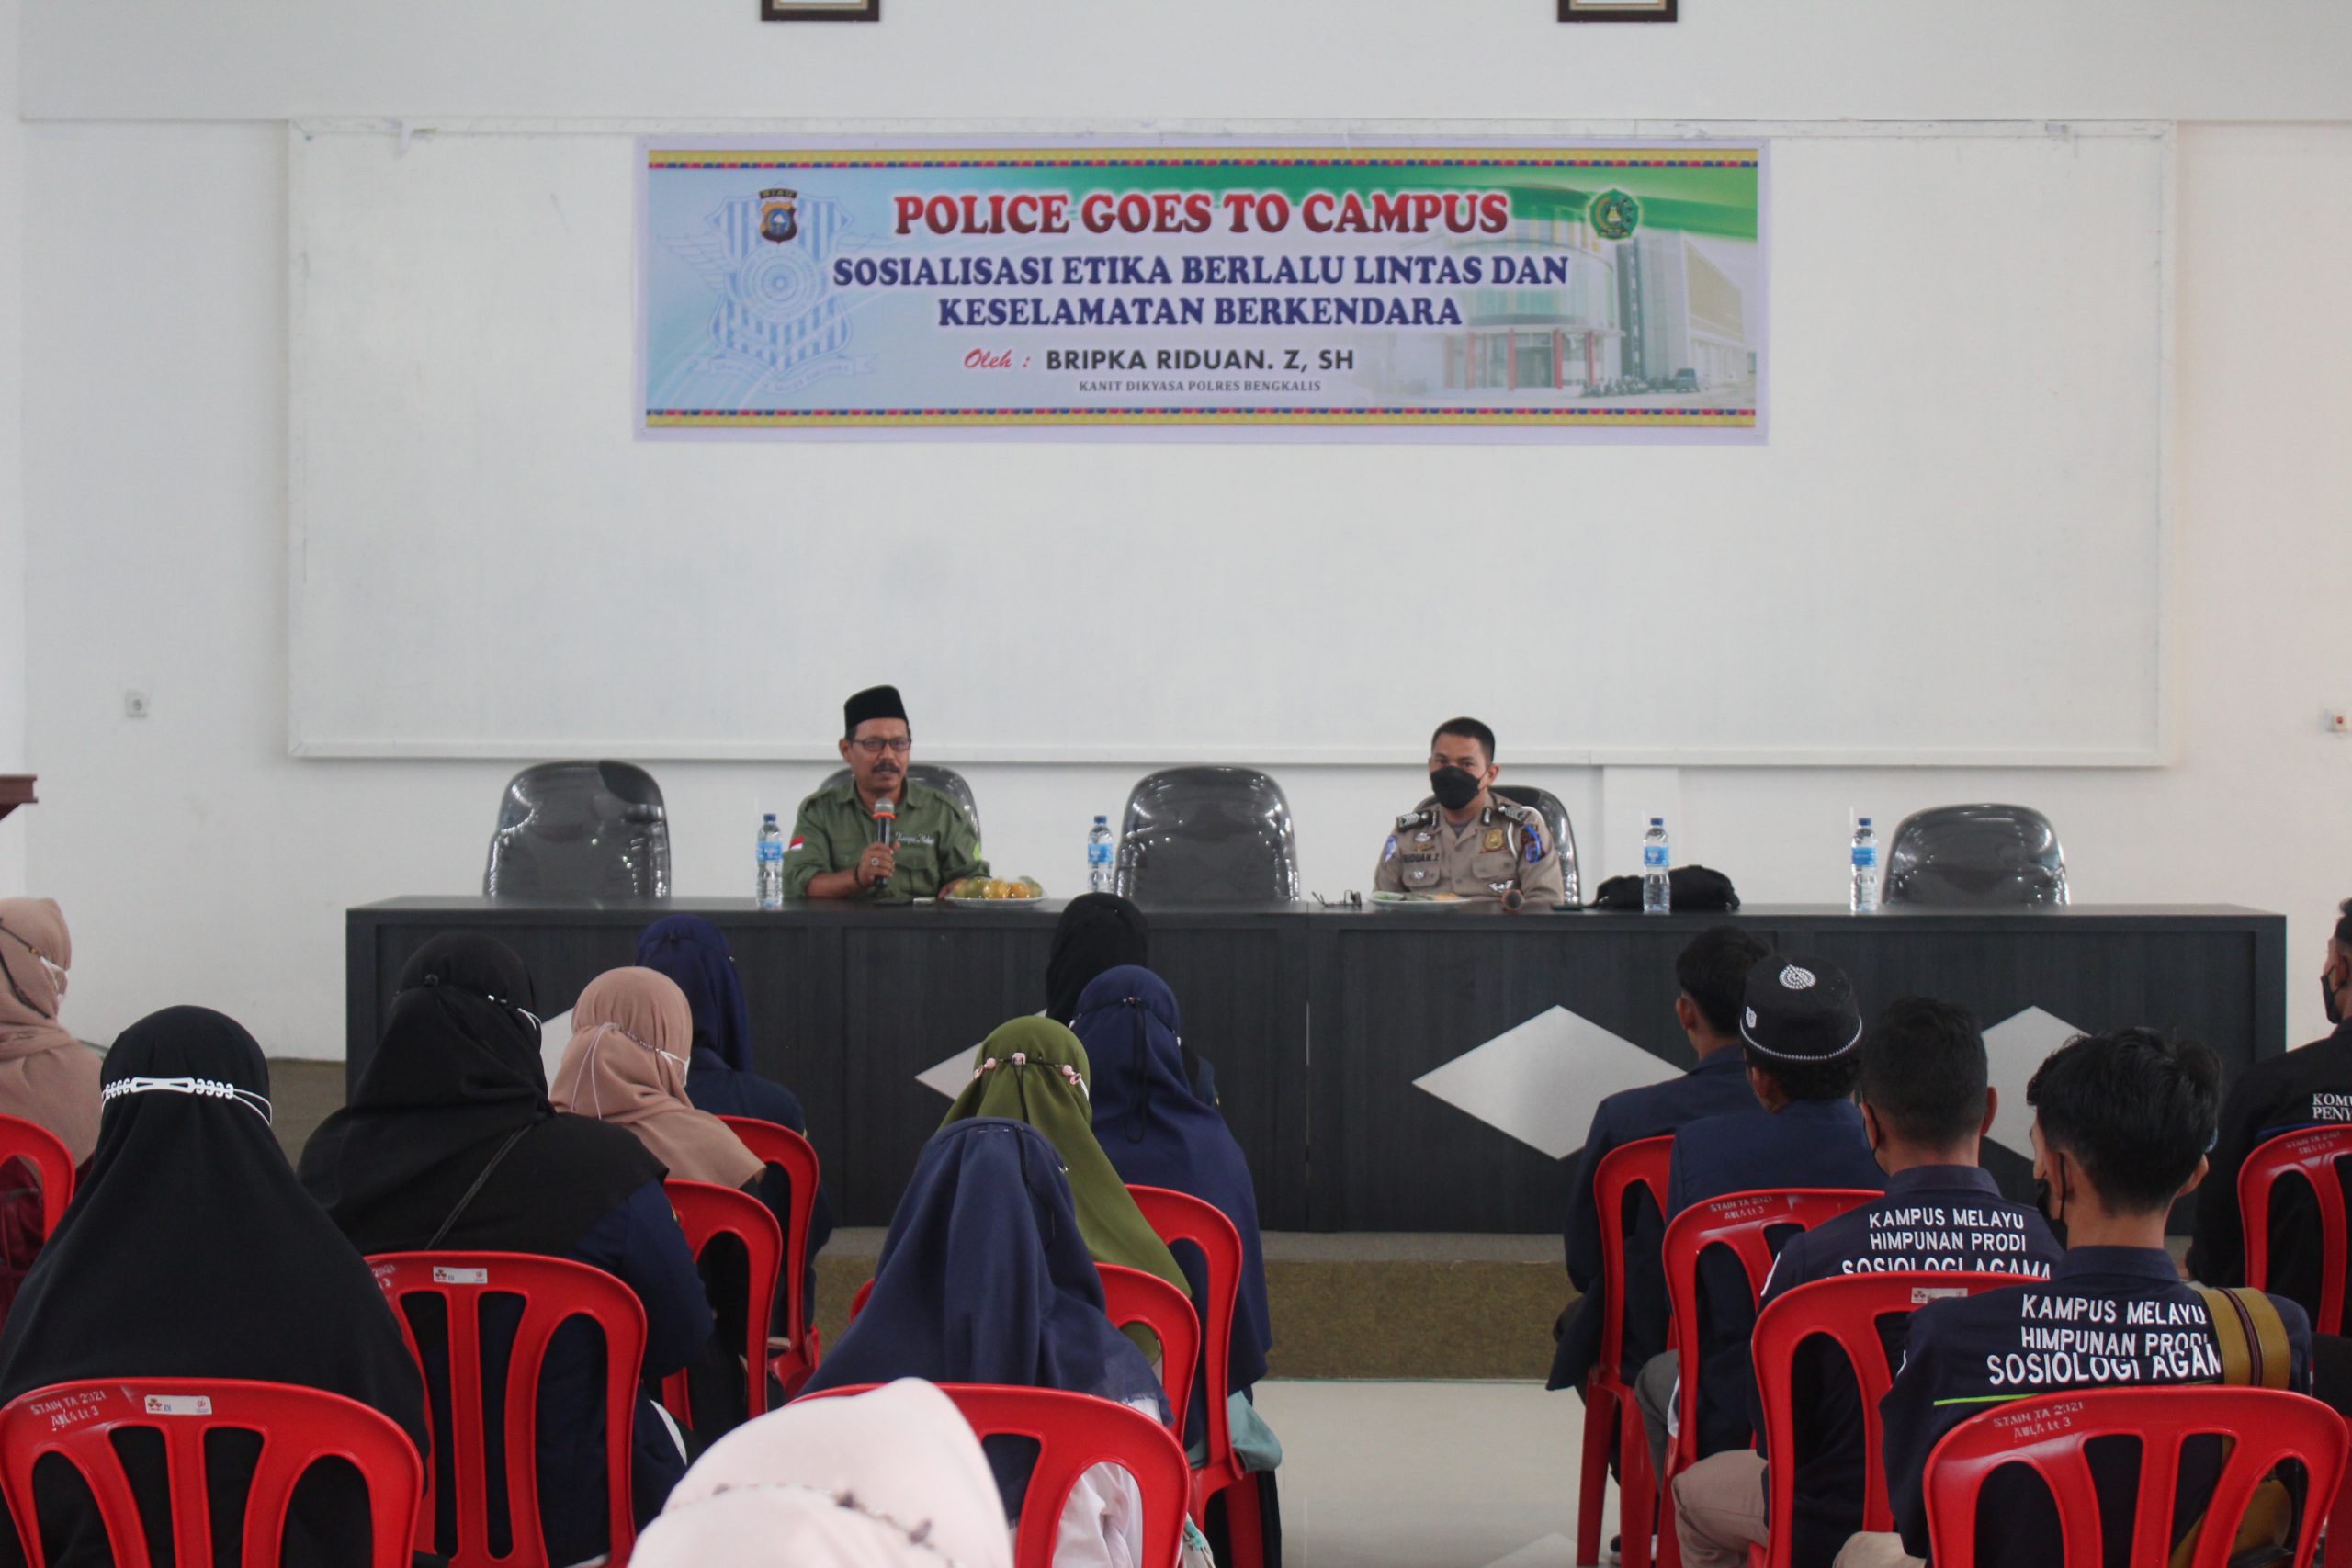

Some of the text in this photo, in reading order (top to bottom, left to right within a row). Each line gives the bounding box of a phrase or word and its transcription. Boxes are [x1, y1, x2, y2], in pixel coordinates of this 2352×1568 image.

[895, 193, 1509, 234] POLICE GOES TO CAMPUS
[833, 255, 1568, 287] SOSIALISASI ETIKA BERLALU LINTAS DAN
[938, 297, 1463, 327] KESELAMATAN BERKENDARA
[963, 347, 1014, 369] Oleh
[1046, 350, 1147, 370] BRIPKA
[1157, 350, 1273, 370] RIDUAN.
[1283, 349, 1307, 373] Z,
[1318, 349, 1354, 370] SH
[1079, 380, 1322, 392] KANIT DIKYASA POLRES BENGKALIS
[2312, 1093, 2352, 1107] KOM
[1869, 1207, 2024, 1230] KAMPUS MELAYU
[1869, 1231, 2027, 1252] HIMPUNAN PRODI
[2021, 1293, 2208, 1325] KAMPUS MELAYU
[2021, 1326, 2136, 1357] HIMPUNAN
[1986, 1352, 2141, 1385] SOSIOLOGI
[29, 1399, 62, 1416] STAIN
